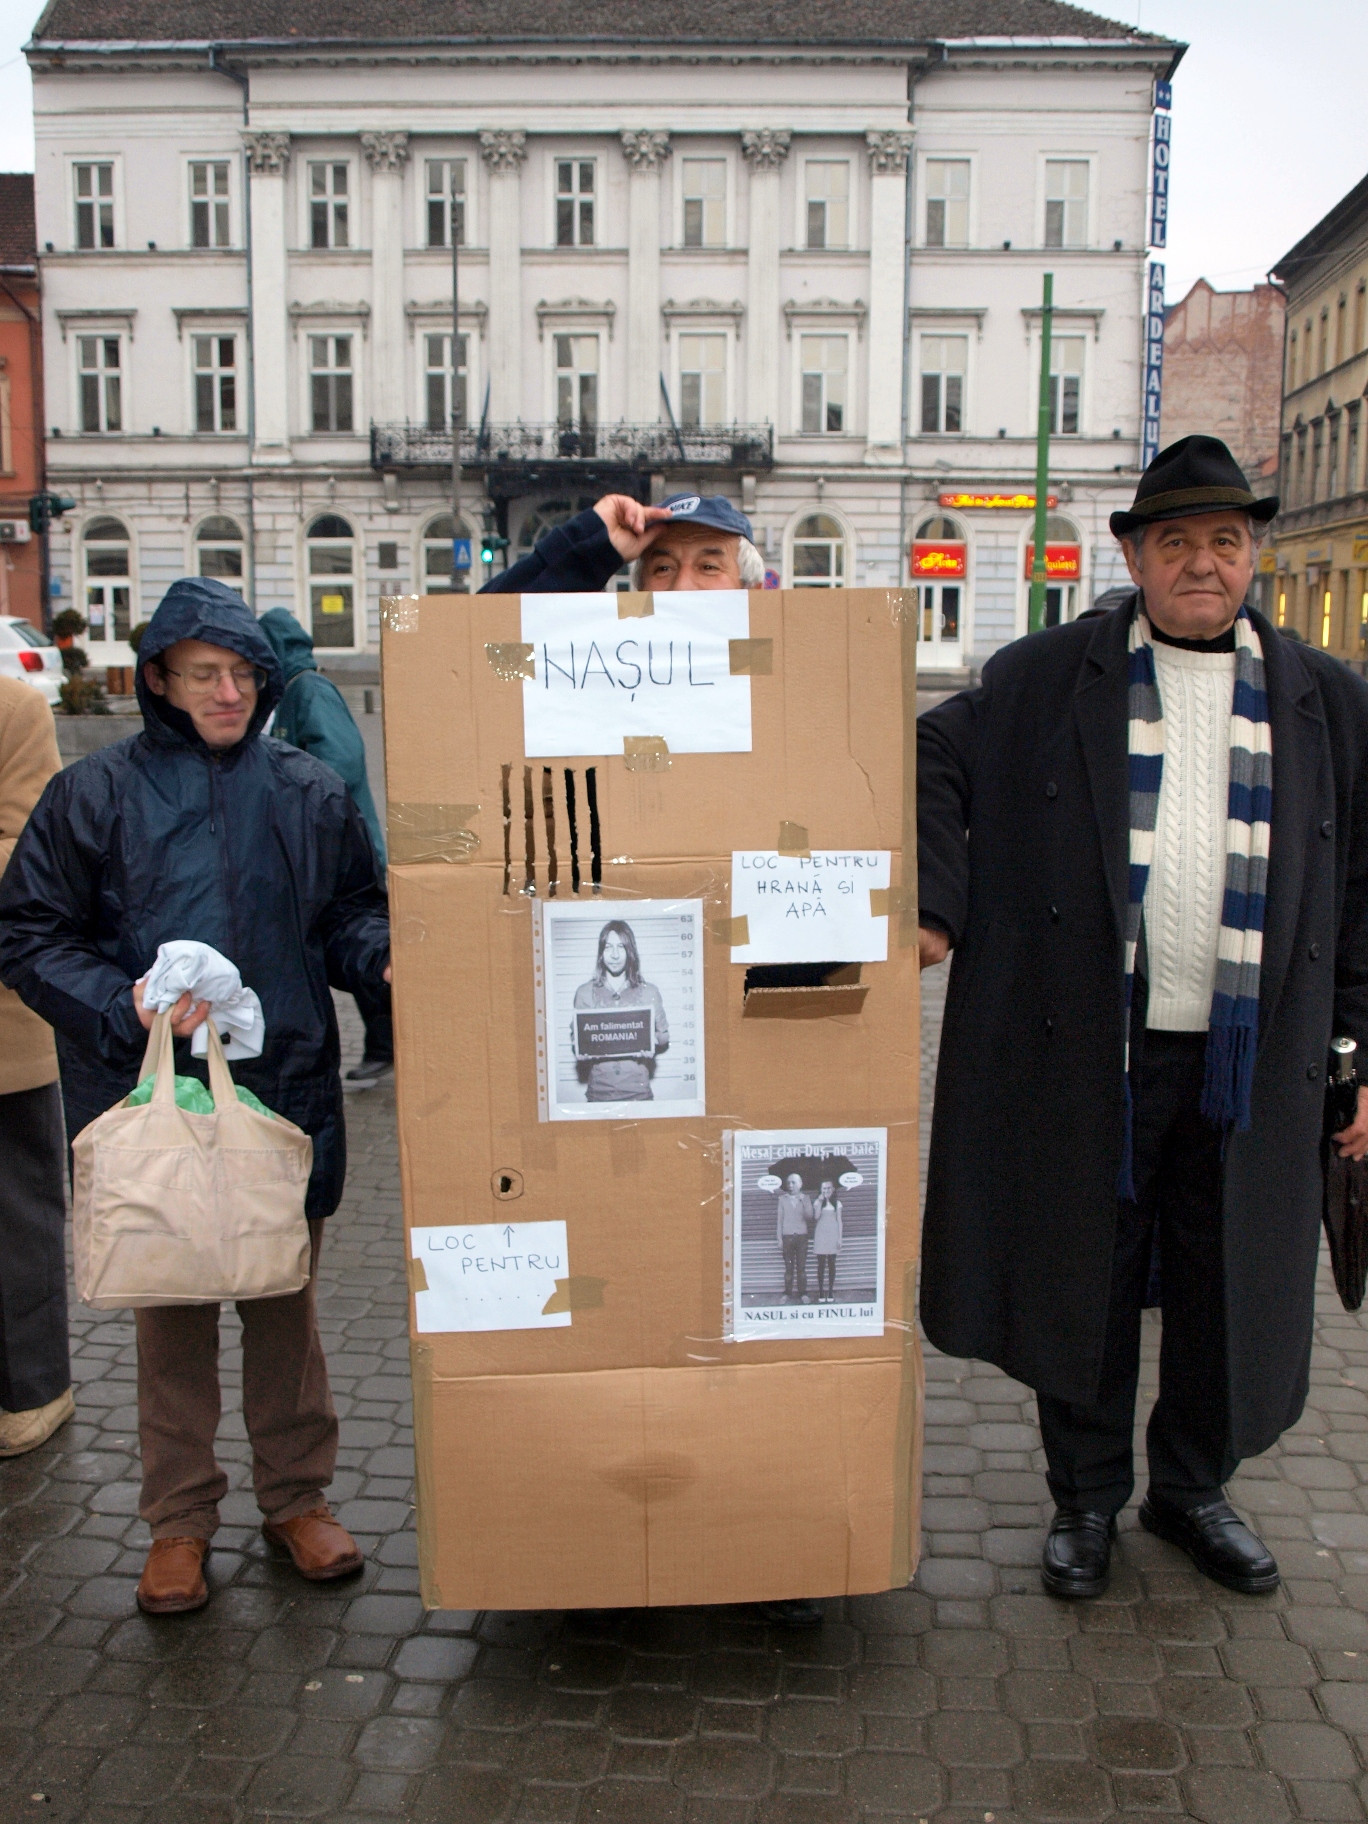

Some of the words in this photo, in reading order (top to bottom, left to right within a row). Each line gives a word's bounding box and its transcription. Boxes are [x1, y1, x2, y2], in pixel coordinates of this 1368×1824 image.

[1152, 116, 1170, 247] HOTEL
[741, 856, 779, 869] LOC
[800, 856, 878, 869] PENTRU
[583, 1023, 599, 1032] Am
[600, 1020, 644, 1031] falimentat
[591, 1031, 638, 1042] ROMANIA!
[741, 1145, 773, 1161] Mesaj
[832, 1147, 848, 1156] nu
[428, 1234, 476, 1251] LOC
[461, 1254, 560, 1275] PENTRU
[744, 1310, 788, 1321] NASUL
[790, 1309, 799, 1319] si
[801, 1310, 814, 1319] cu
[818, 1308, 856, 1318] FINUL
[859, 1307, 874, 1317] lui
